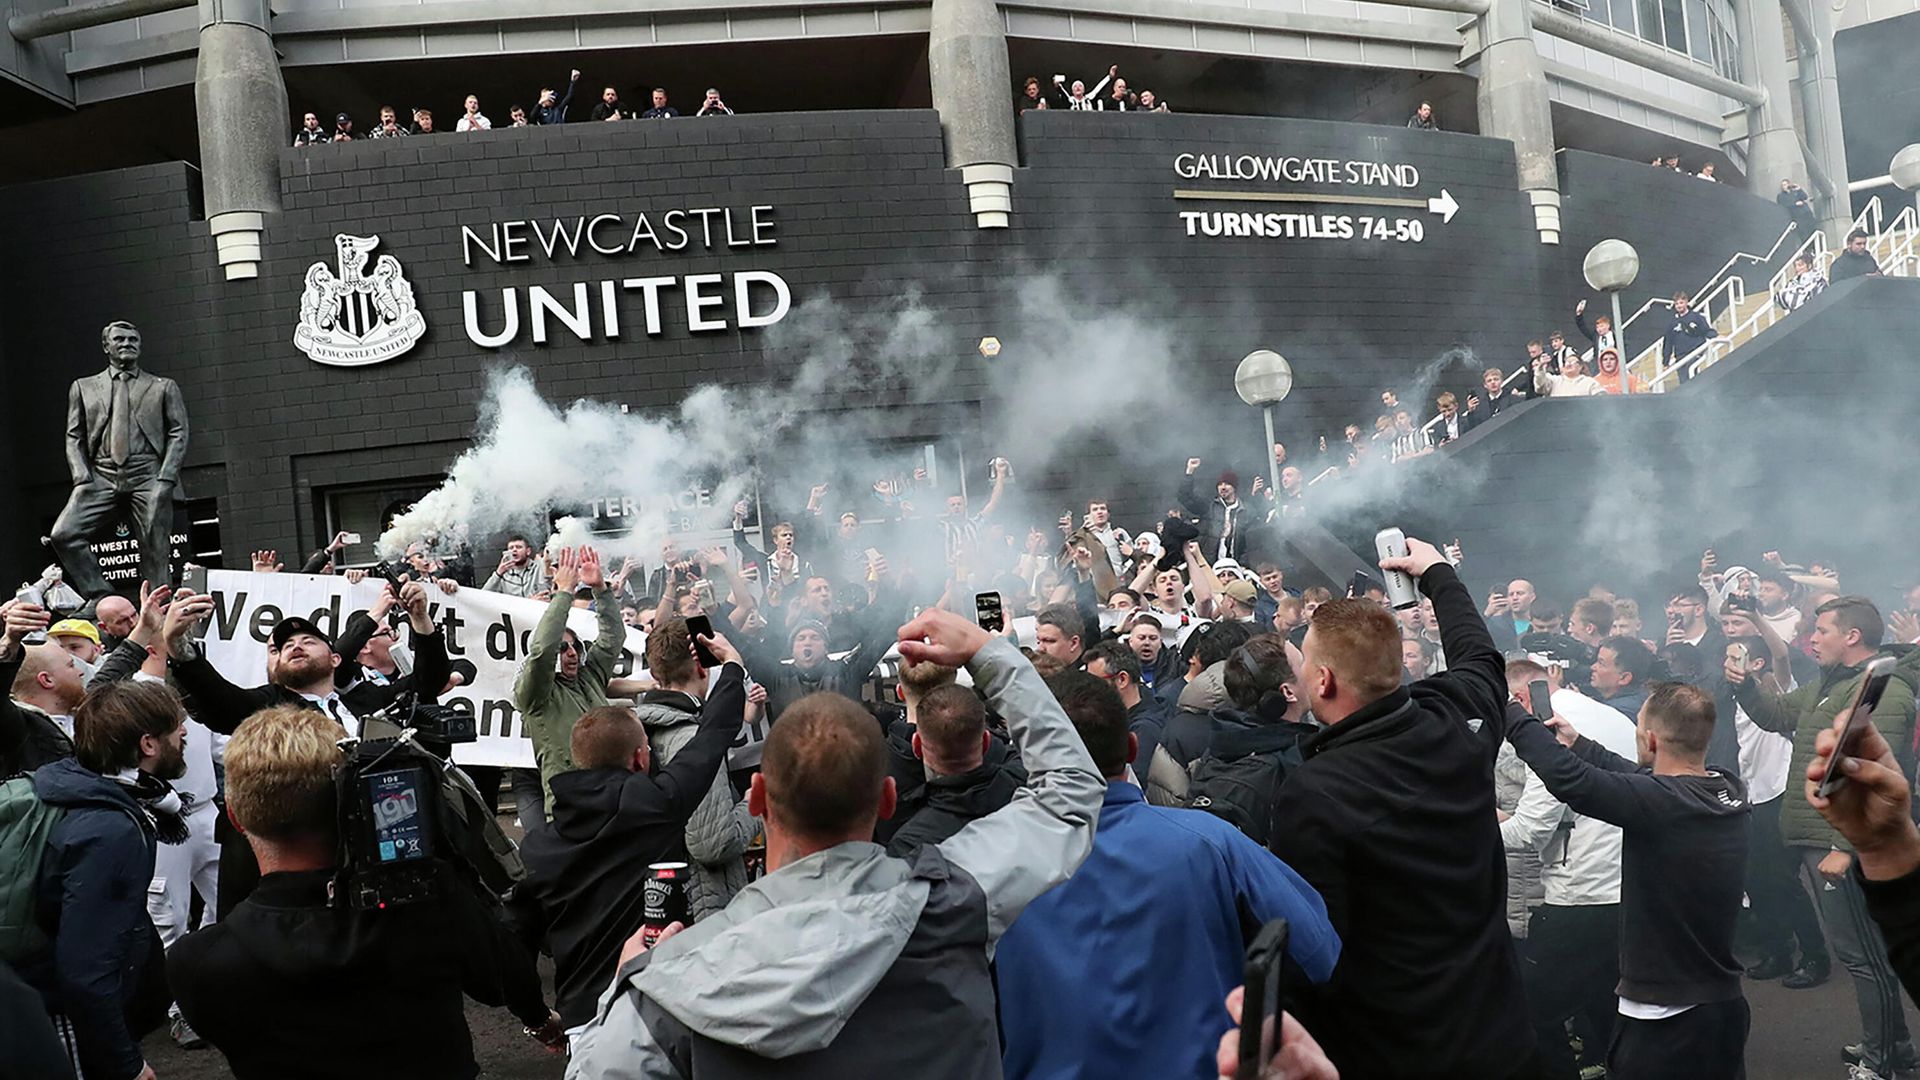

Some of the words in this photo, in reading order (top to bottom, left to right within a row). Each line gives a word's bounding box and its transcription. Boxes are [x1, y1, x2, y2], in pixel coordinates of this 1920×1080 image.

[1174, 153, 1342, 183] GALLOWGATE
[1346, 161, 1420, 188] STAND
[461, 205, 777, 266] NEWCASTLE
[1179, 211, 1354, 239] TURNSTILES
[1358, 217, 1424, 242] 74-50
[462, 270, 792, 348] UNITED
[316, 347, 371, 359] NEWCASTLE
[371, 337, 408, 355] UNITED
[588, 489, 712, 518] TERACE
[99, 540, 128, 552] WEST
[99, 553, 141, 566] OWGATE
[102, 569, 137, 581] CUTIVE
[202, 590, 284, 642] We
[309, 594, 465, 656] dn't
